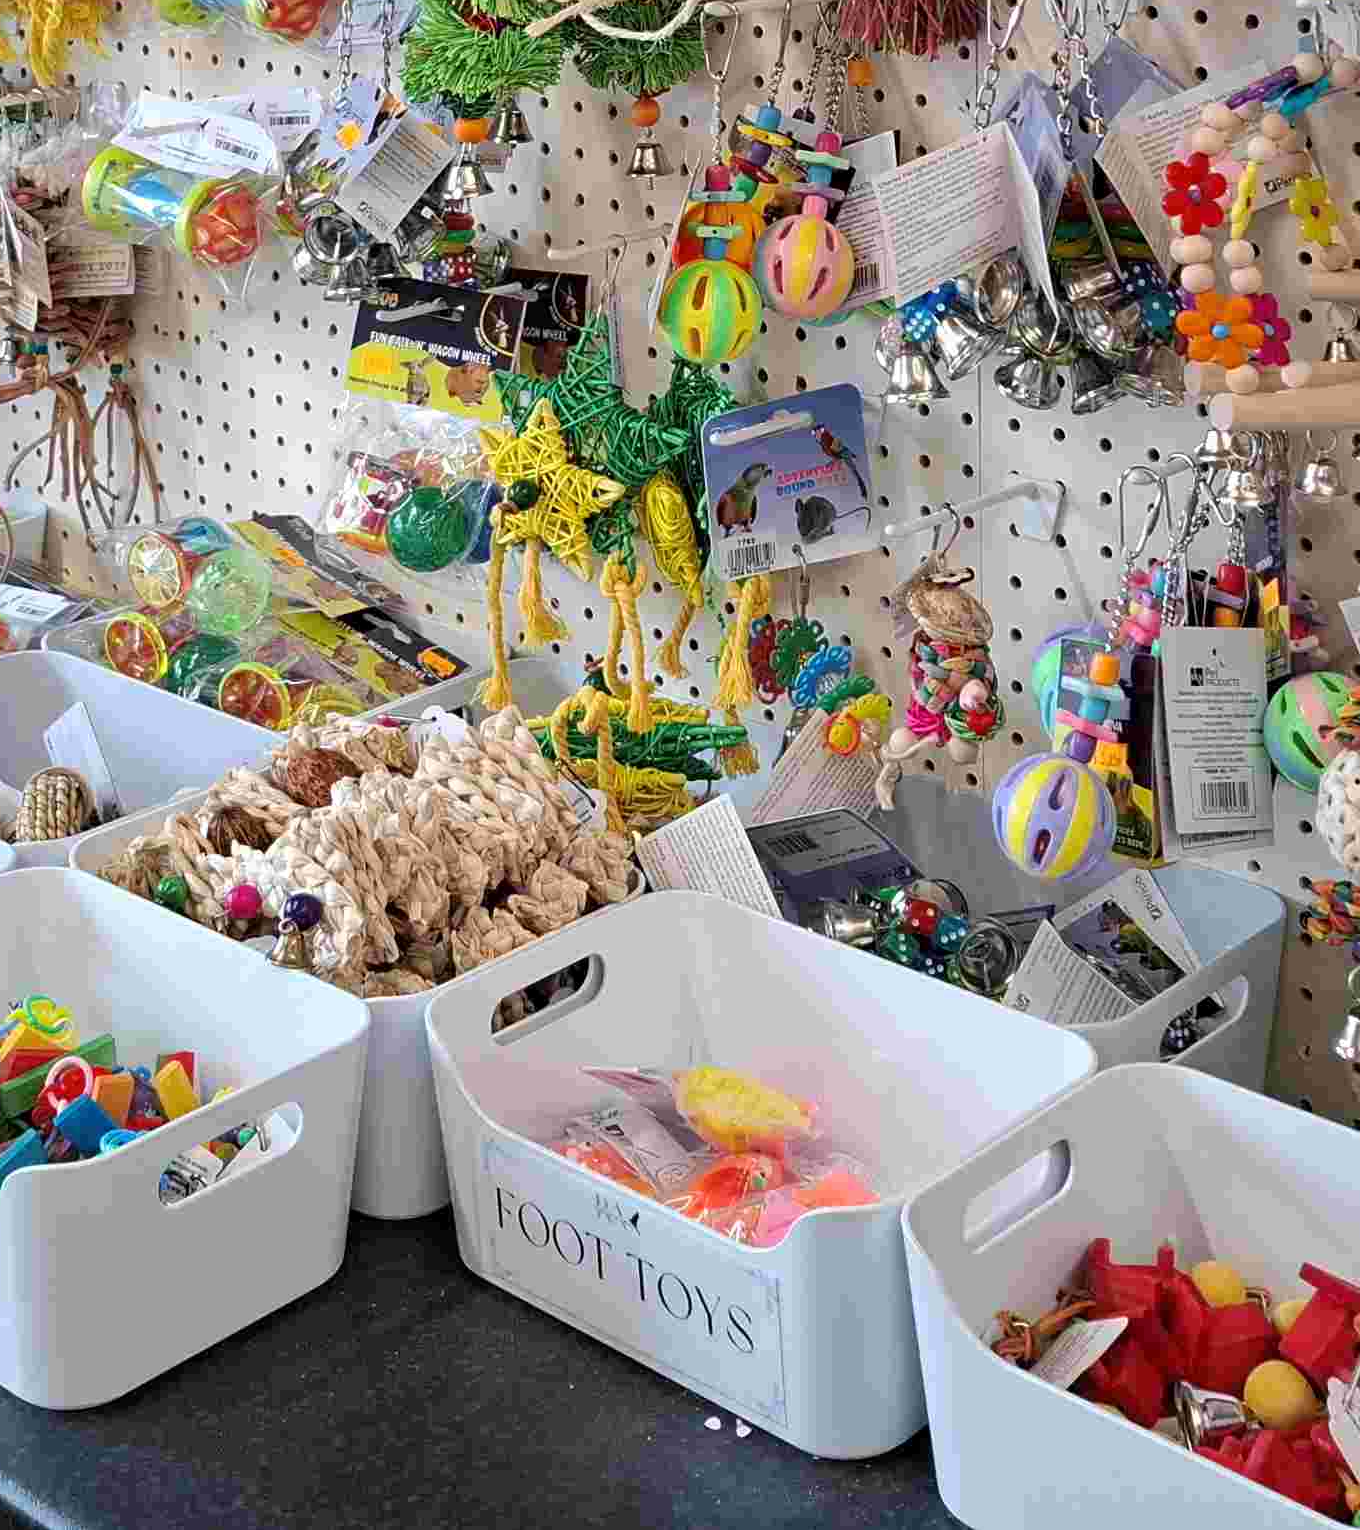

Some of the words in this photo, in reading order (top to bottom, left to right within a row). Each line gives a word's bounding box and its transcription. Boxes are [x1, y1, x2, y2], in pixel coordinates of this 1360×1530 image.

[427, 341, 460, 361] WAGON
[461, 349, 492, 367] WHEEL
[496, 1184, 613, 1281] FOOT
[625, 1250, 755, 1355] TOYS
